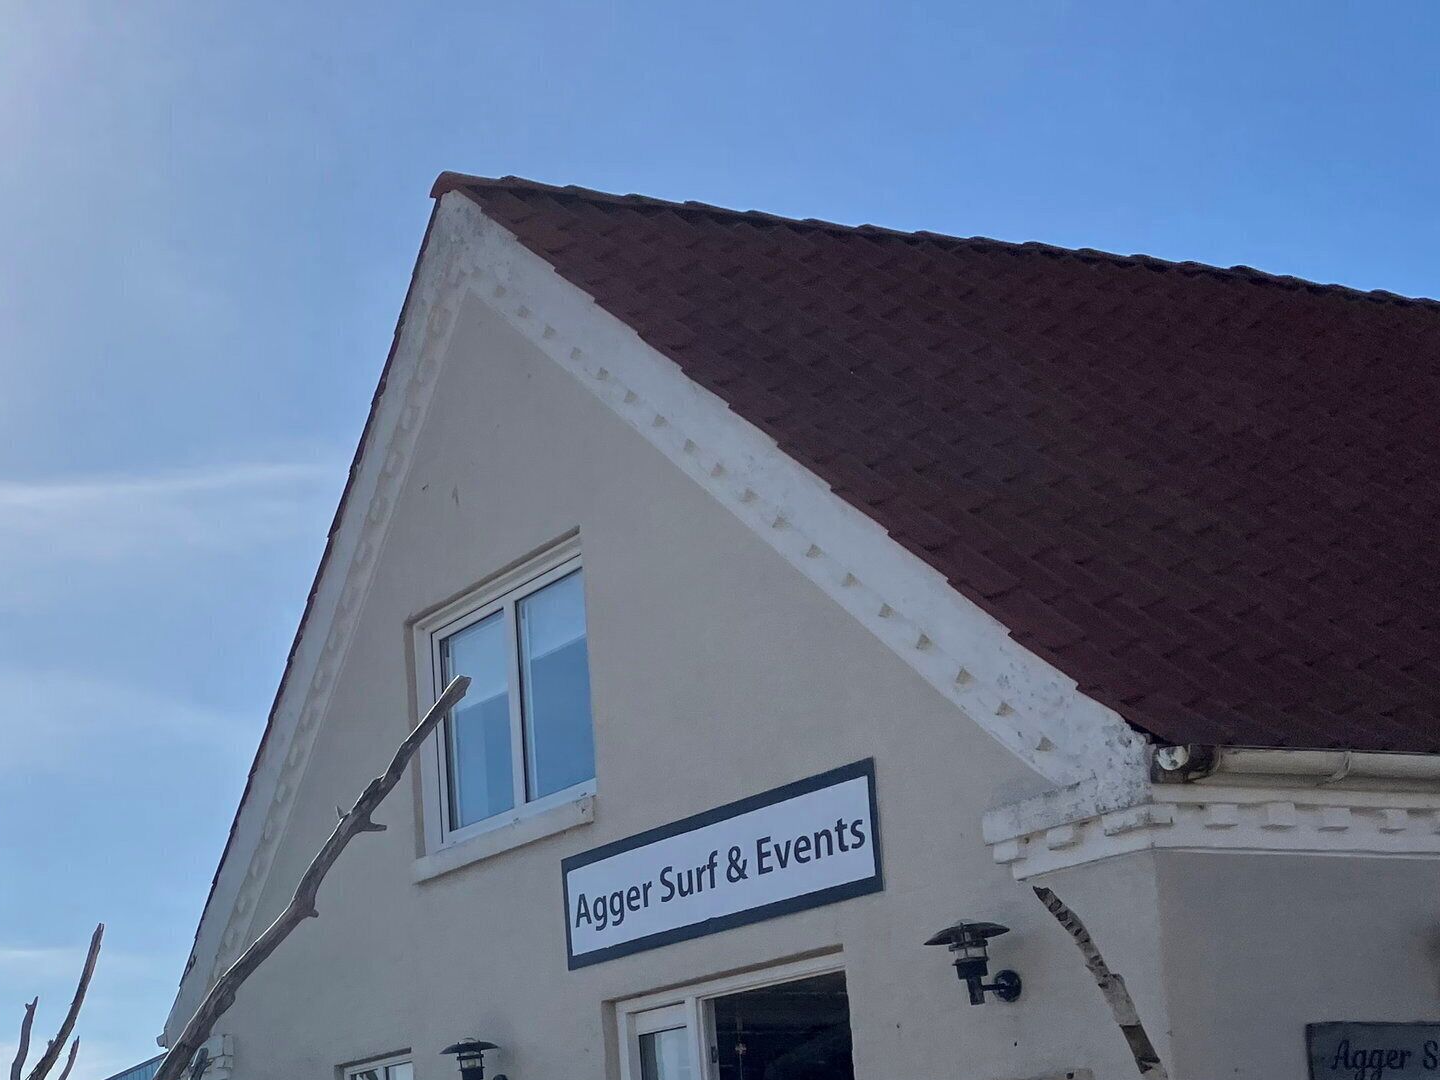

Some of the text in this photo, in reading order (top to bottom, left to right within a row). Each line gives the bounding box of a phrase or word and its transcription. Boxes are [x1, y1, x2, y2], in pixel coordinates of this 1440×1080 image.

[574, 818, 866, 931] Agger Surf & Events
